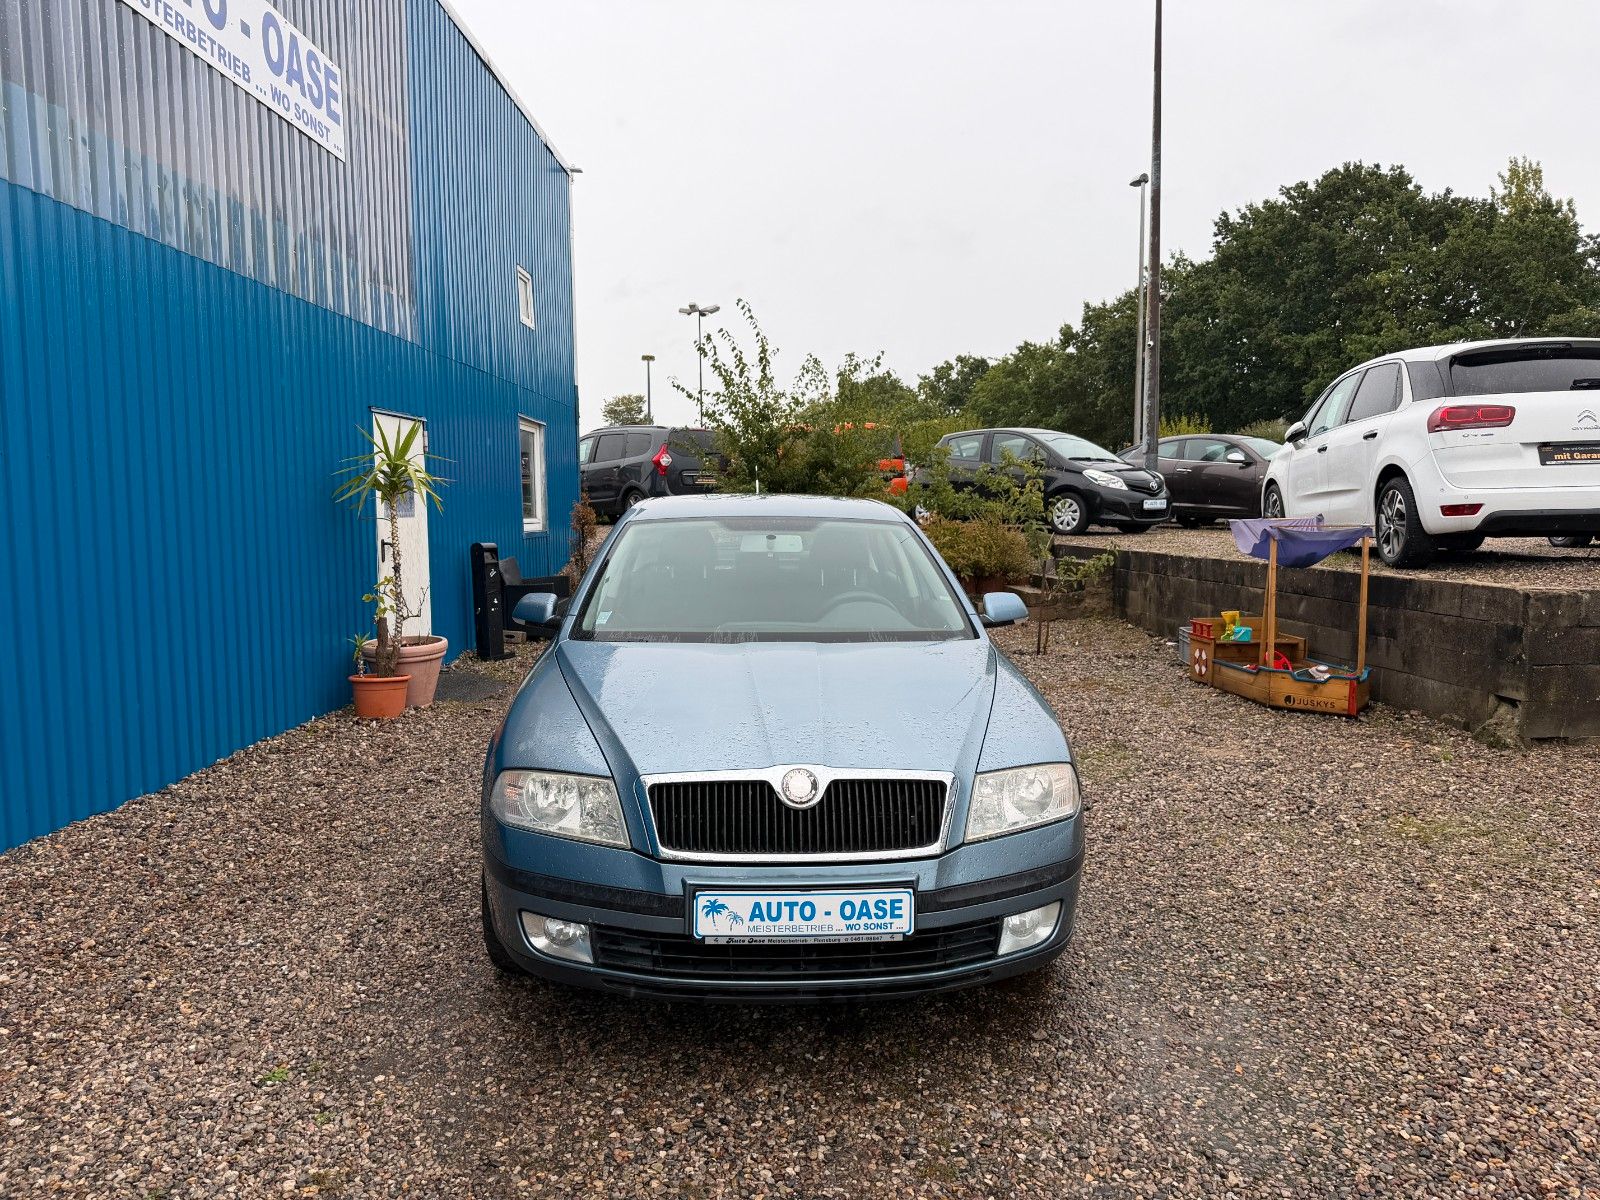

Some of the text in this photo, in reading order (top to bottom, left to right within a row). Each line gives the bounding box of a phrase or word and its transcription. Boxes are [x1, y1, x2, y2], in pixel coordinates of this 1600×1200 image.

[261, 10, 341, 127] OASE
[270, 83, 291, 112] WO
[294, 102, 331, 142] SONST
[1554, 452, 1571, 460] mit
[1296, 697, 1336, 709] JUSKYS
[748, 901, 817, 922] AUTO
[839, 899, 903, 921] OASE
[747, 924, 834, 933] MEISTERBETRIEB
[845, 923, 861, 931] WO
[863, 922, 894, 930] SONST
